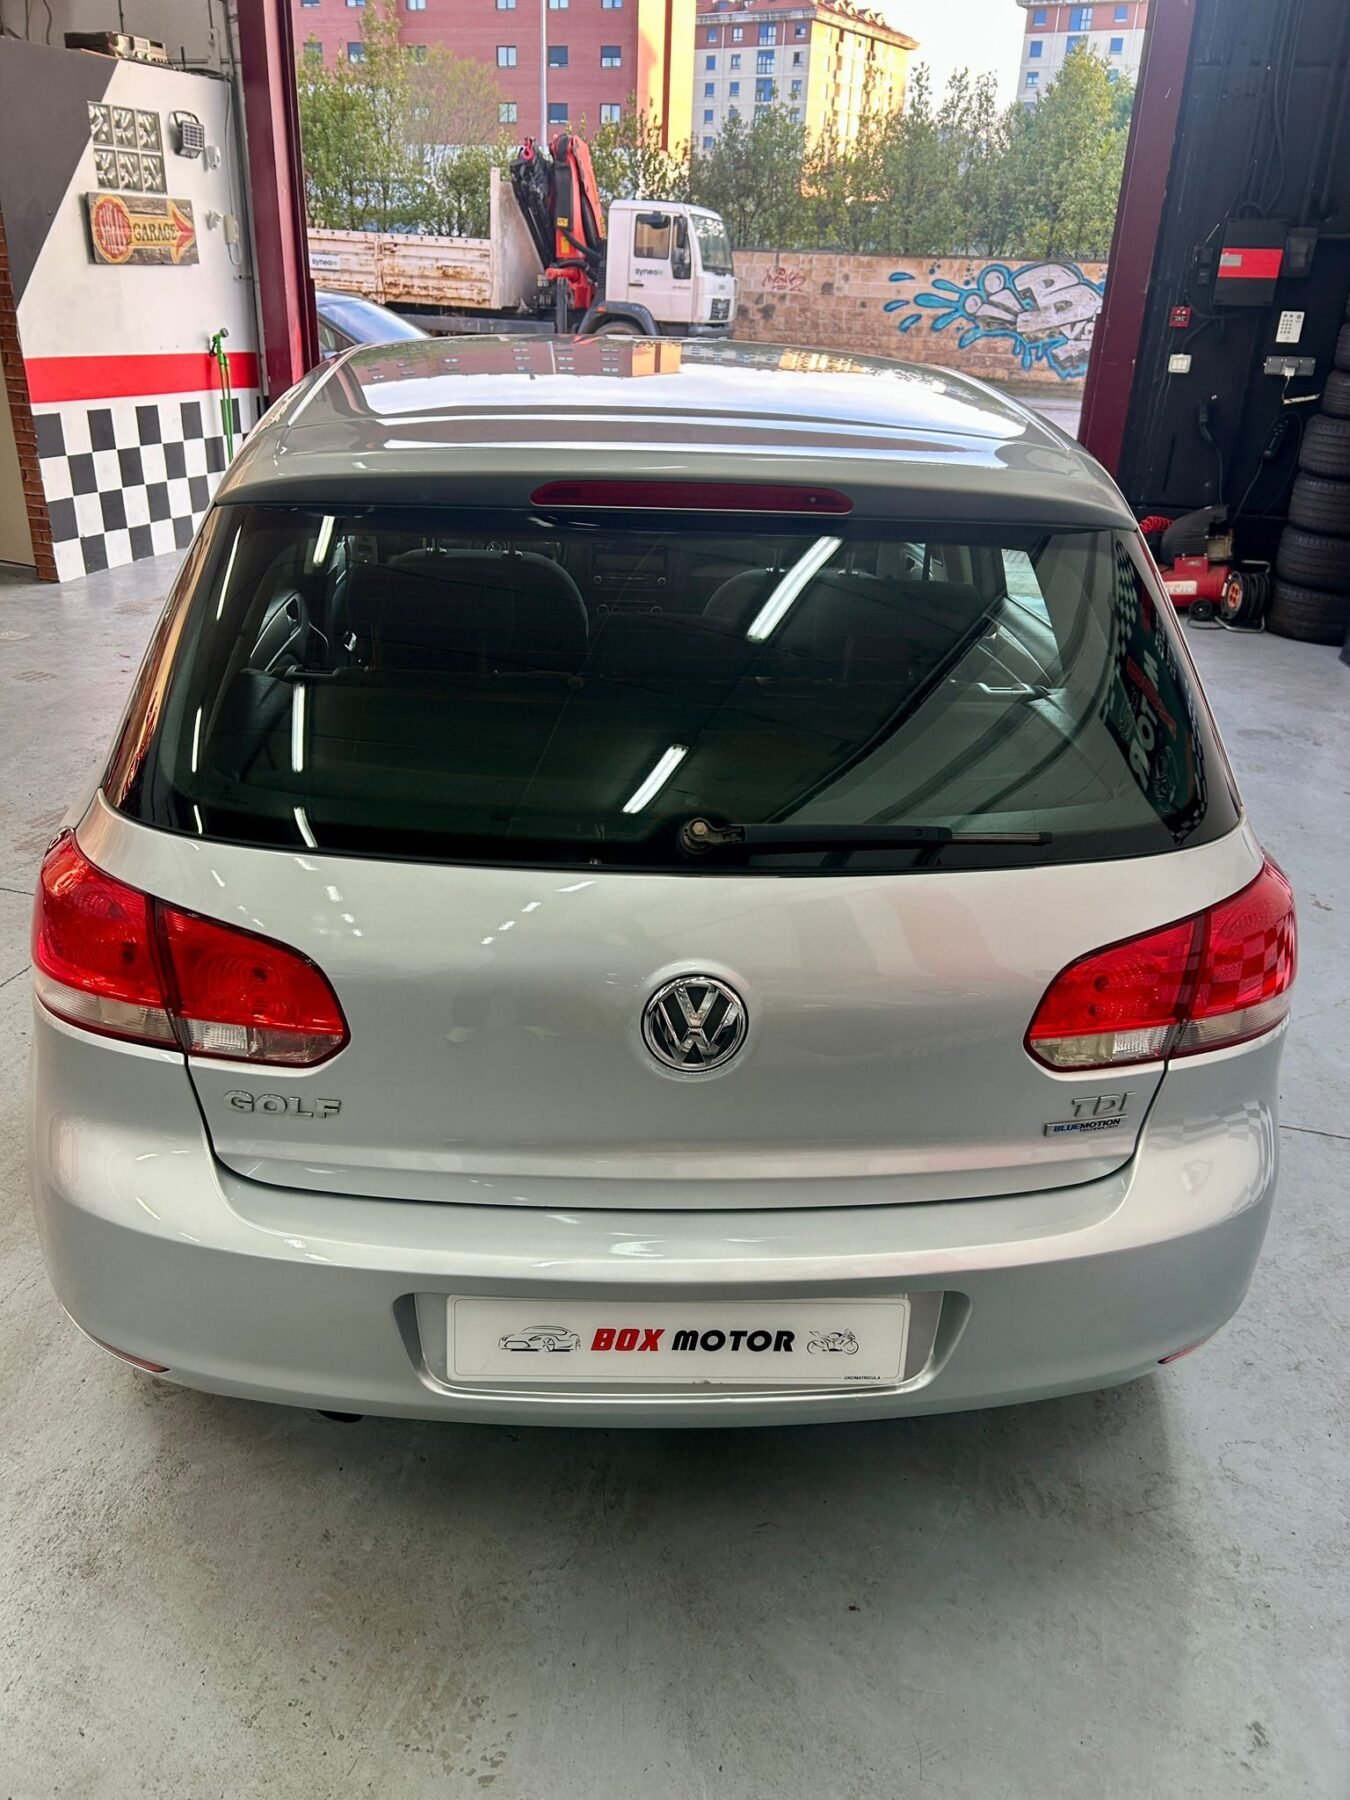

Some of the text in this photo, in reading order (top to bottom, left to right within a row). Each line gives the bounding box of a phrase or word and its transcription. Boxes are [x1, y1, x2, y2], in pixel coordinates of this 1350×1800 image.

[132, 222, 178, 242] GARAGE
[223, 1089, 342, 1119] GOLF
[1070, 1090, 1136, 1117] TDI
[1052, 1118, 1121, 1132] BLUEMOTION
[590, 1328, 796, 1353] BOX MOTOR
